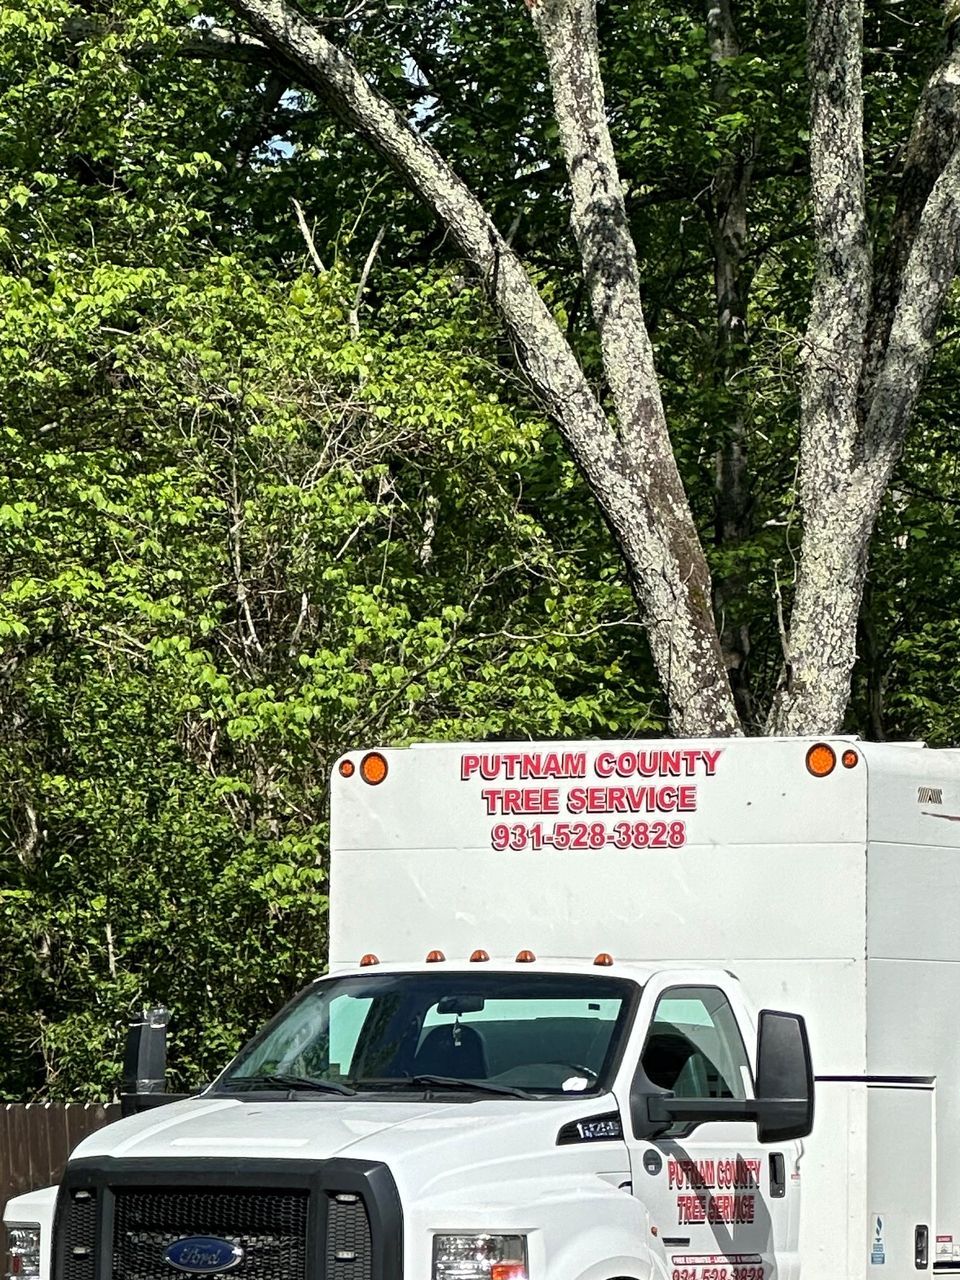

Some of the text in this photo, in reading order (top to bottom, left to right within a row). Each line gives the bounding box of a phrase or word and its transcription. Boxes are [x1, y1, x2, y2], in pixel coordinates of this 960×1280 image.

[461, 748, 724, 780] PUTNAM COUNTY
[482, 785, 697, 815] TREE SERVICE
[491, 820, 686, 851] 931-528-3828
[667, 1158, 762, 1190] PUTNAM COUNTY
[677, 1195, 755, 1225] TREE SERVICE
[180, 1247, 222, 1265] Ford
